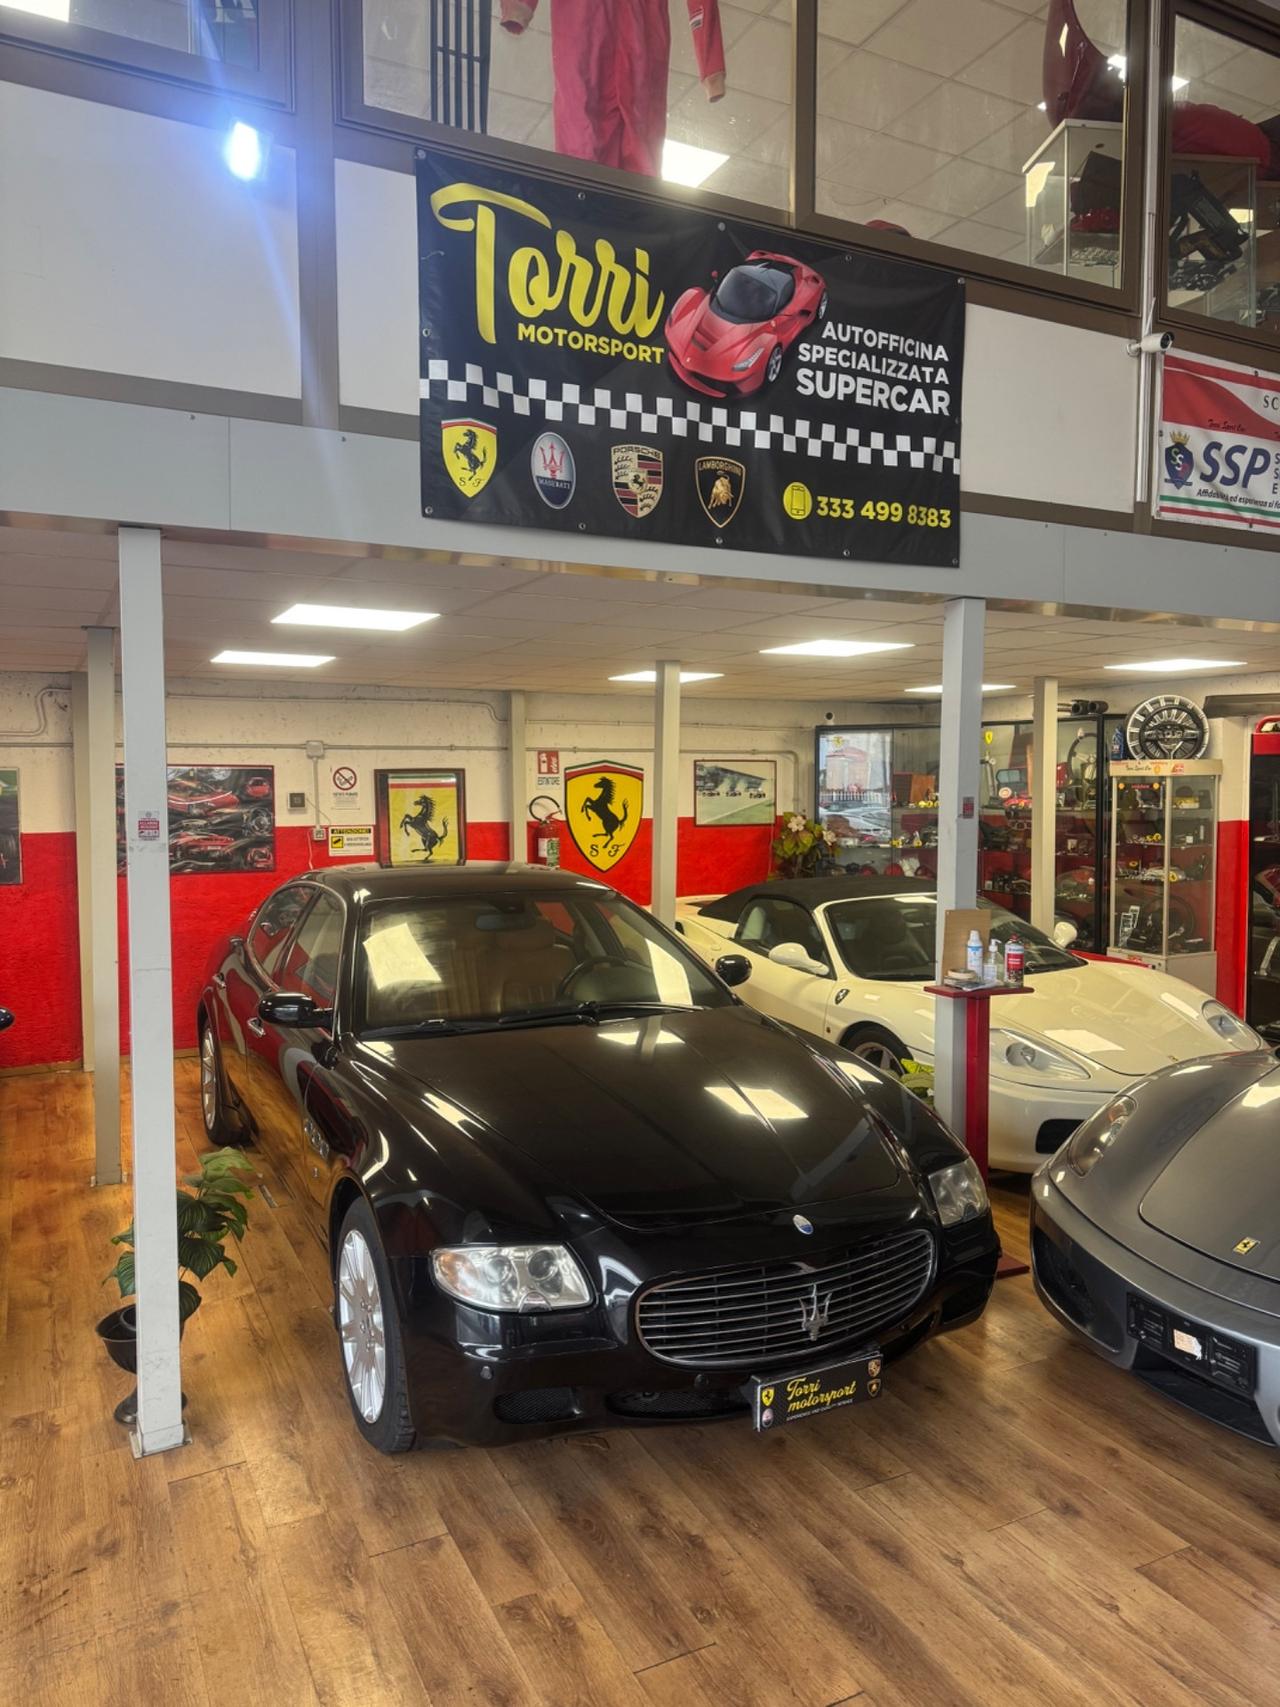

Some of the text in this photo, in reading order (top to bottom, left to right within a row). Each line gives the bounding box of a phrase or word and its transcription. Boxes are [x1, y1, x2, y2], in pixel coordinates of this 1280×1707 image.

[430, 182, 665, 344] Torri
[518, 322, 665, 364] MOTORSPORT
[821, 321, 949, 362] AUTOFFICINA
[798, 343, 950, 385] SPECIALIZZATA
[796, 367, 950, 416] SUPERCAR
[612, 445, 661, 459] PORSCHE
[1200, 441, 1271, 488] SSP
[816, 495, 951, 528] 333 499 8383
[786, 1377, 820, 1400] Torri
[787, 1380, 857, 1413] motorsport
